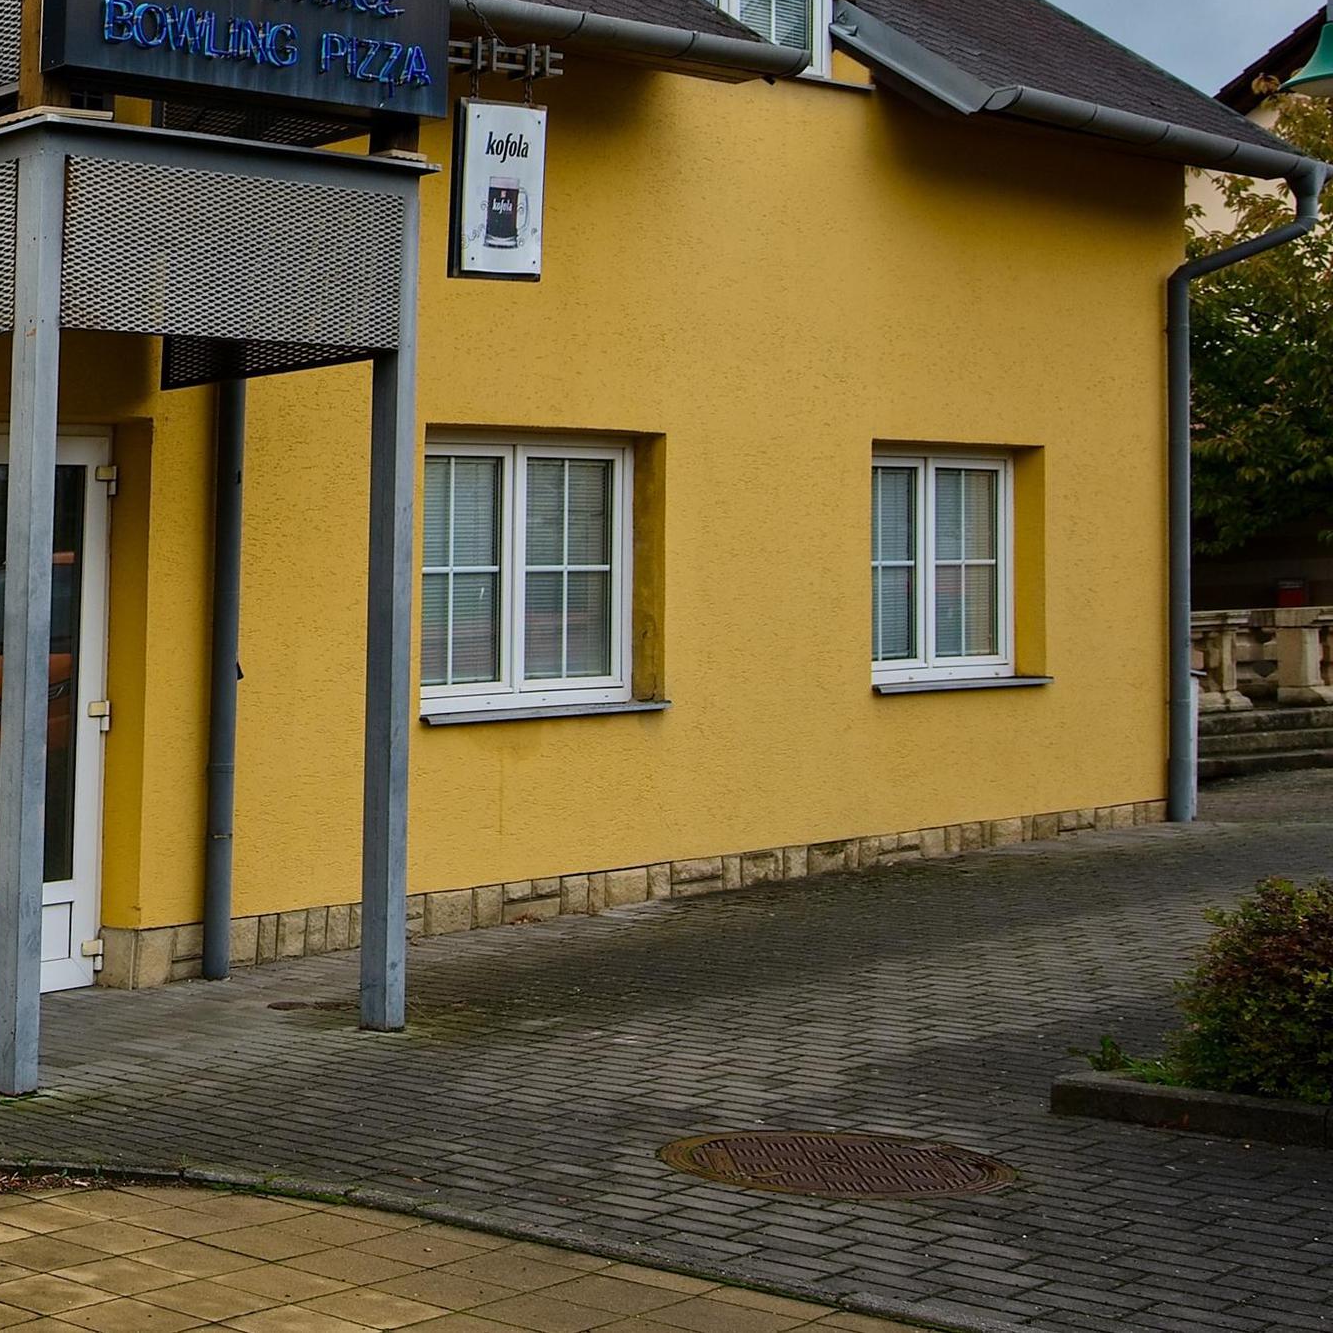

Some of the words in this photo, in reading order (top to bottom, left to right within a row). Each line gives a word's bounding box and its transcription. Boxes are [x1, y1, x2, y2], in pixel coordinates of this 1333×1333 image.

[320, 31, 432, 91] PIZZA
[485, 131, 530, 164] kofola
[492, 197, 513, 214] kofola
